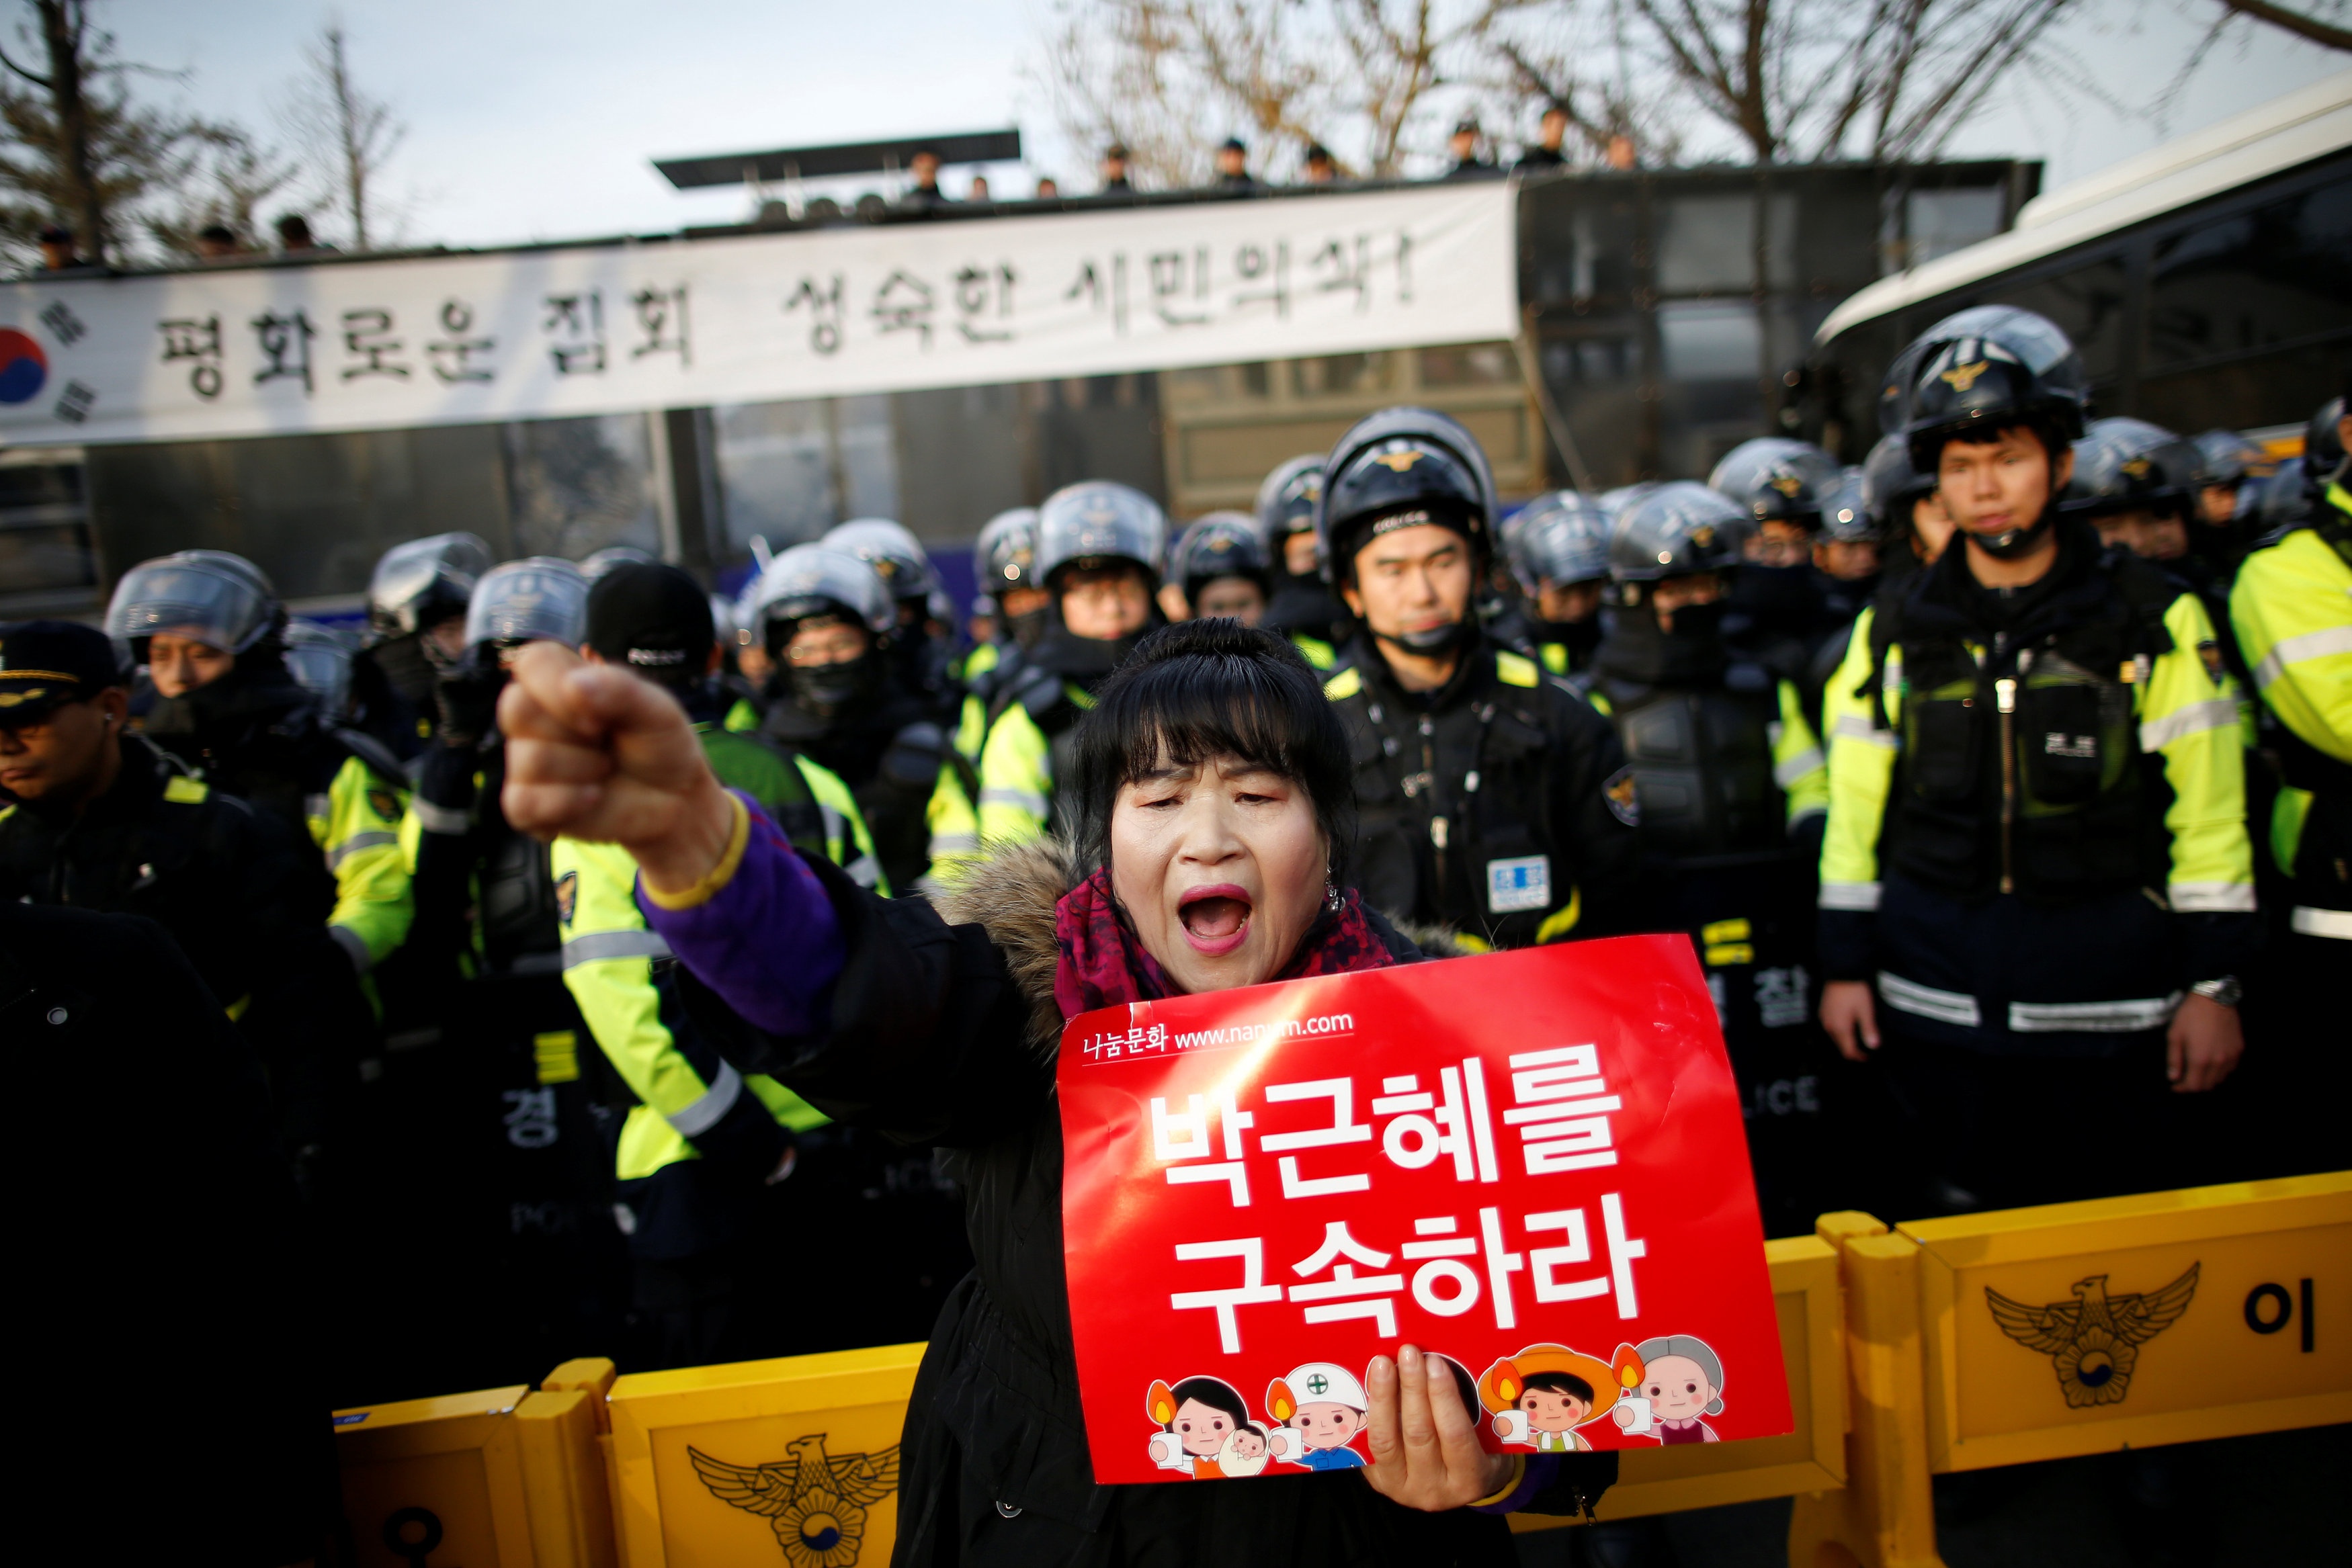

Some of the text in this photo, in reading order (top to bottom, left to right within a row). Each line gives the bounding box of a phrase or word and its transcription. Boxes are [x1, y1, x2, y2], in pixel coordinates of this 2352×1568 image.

[157, 297, 497, 400] 평화로운
[542, 279, 695, 372] 집회
[782, 262, 1023, 355] 성숙한
[1083, 1012, 1353, 1060] 나눔문화 www.nanm.com
[1150, 1044, 1622, 1208] 박근혜를
[1169, 1193, 1646, 1354] 구속하라
[2244, 1276, 2315, 1354] 이
